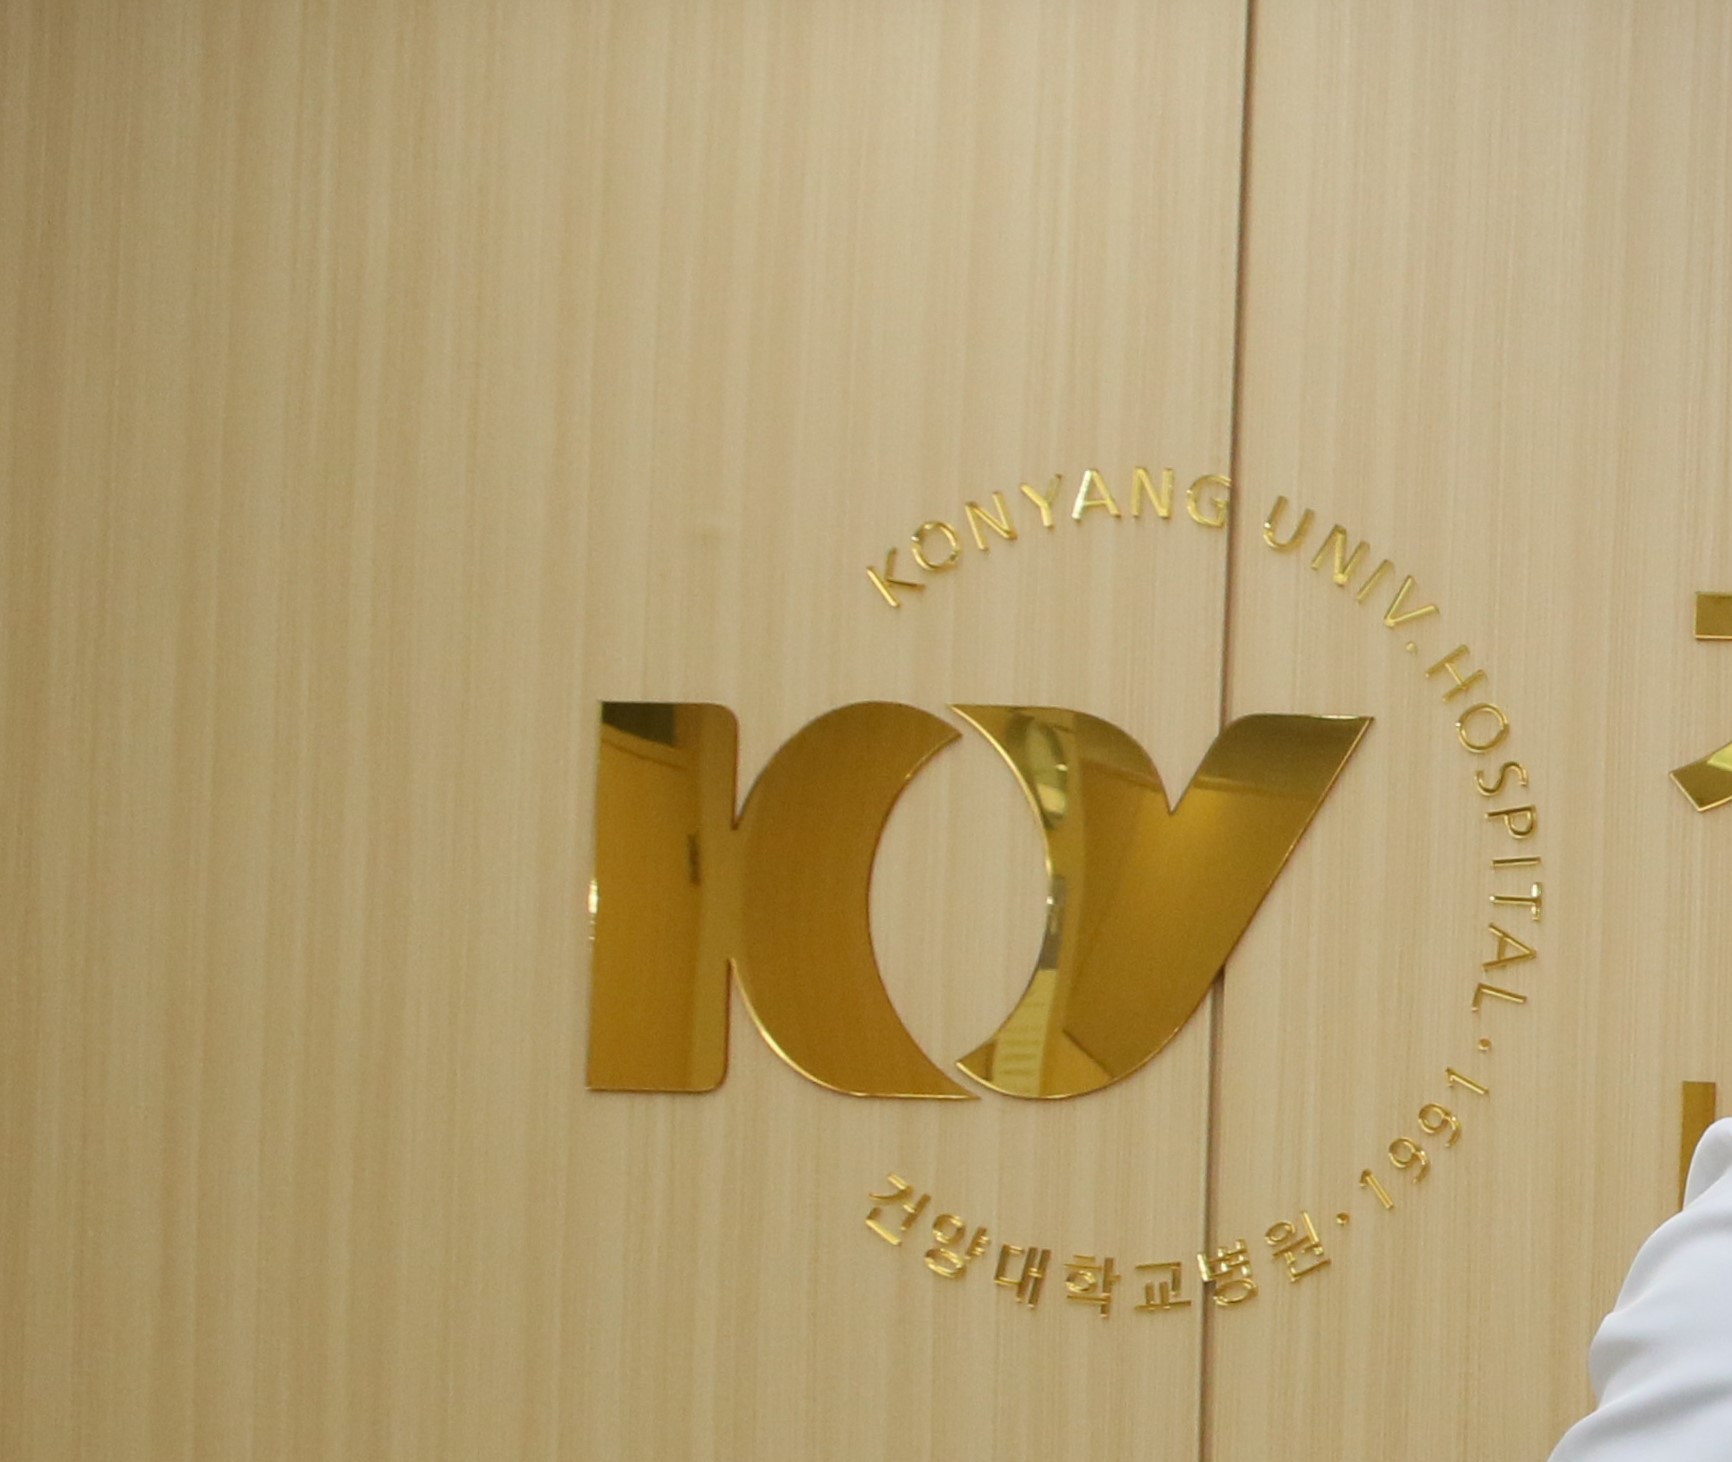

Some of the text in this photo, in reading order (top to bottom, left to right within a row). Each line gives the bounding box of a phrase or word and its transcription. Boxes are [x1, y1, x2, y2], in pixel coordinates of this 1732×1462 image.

[866, 465, 1231, 607] KONYANG
[1426, 643, 1544, 1012] HOSPITAL
[865, 1173, 1331, 1319] 건양대학교병원
